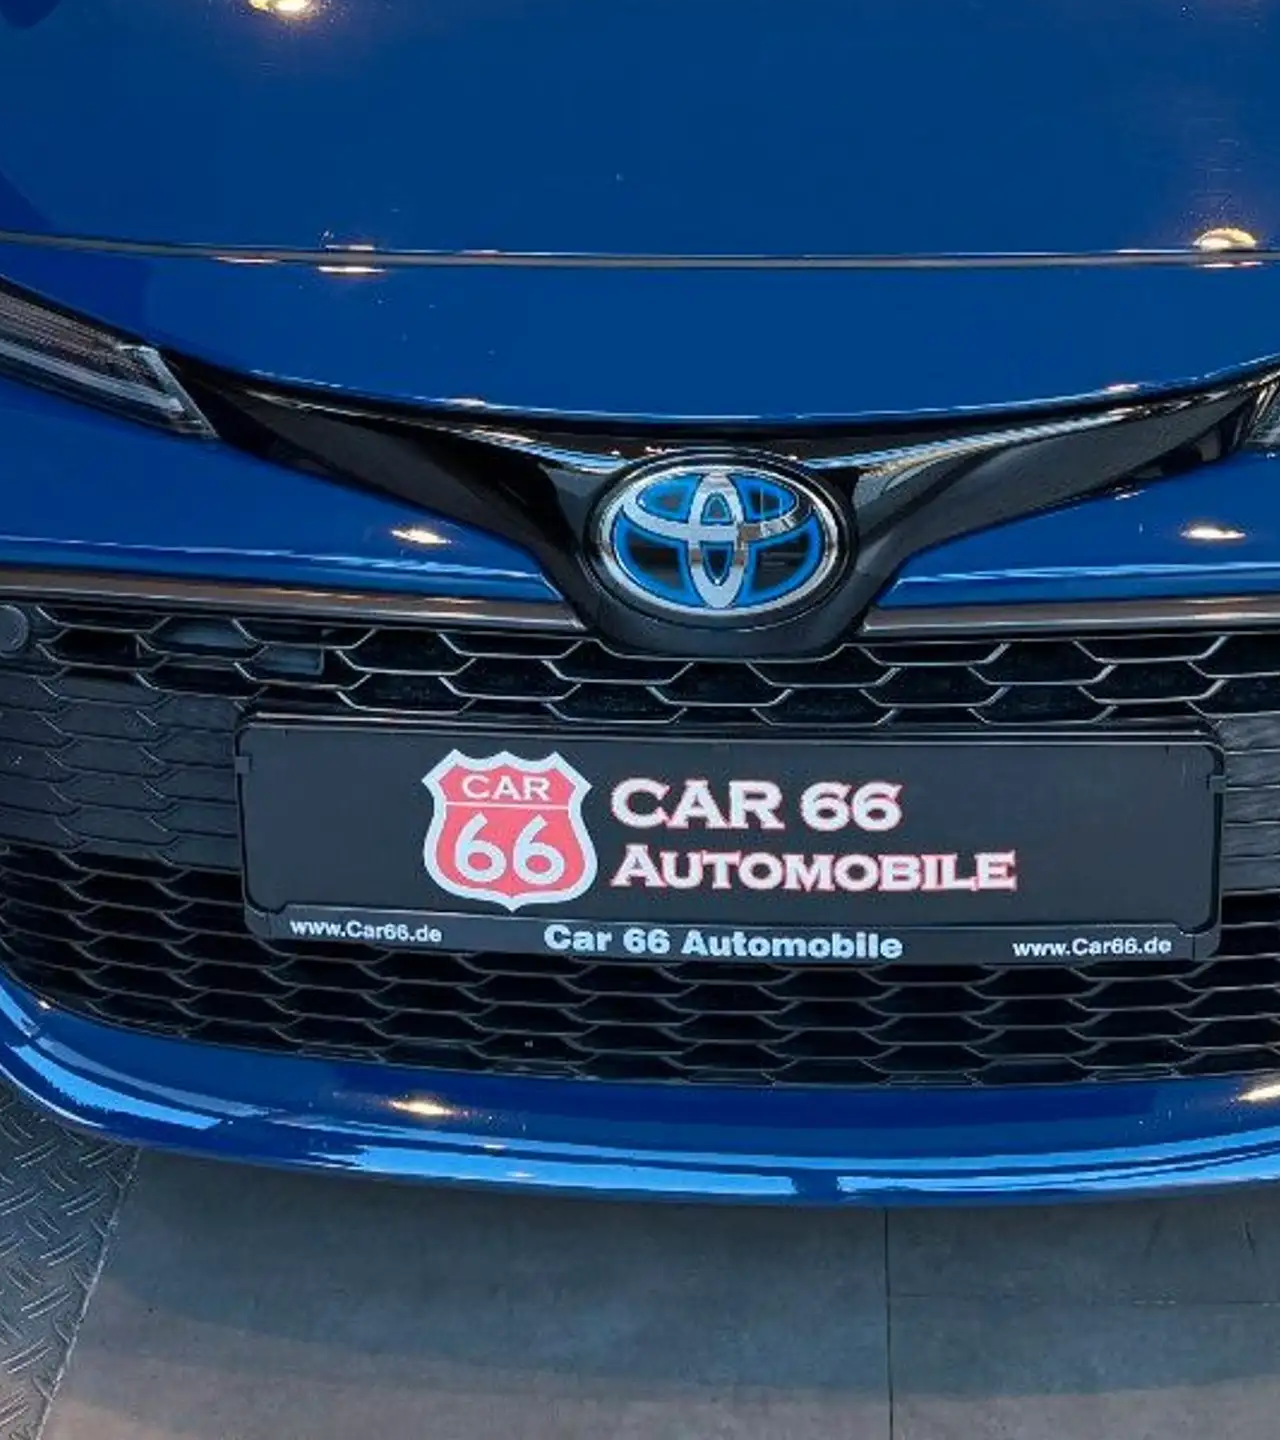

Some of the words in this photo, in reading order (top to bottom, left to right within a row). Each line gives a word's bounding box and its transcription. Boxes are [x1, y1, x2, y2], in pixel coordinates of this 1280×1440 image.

[461, 774, 551, 802] CAR
[610, 777, 786, 830] CAR
[800, 780, 903, 832] 66
[454, 811, 565, 886] 66
[610, 843, 1019, 893] AUTOMOBILE
[289, 918, 443, 943] www.Car66.de
[543, 923, 613, 953] Car
[622, 927, 671, 955] 66
[680, 928, 904, 960] Automobile
[1011, 935, 1173, 958] www.Car66.de
